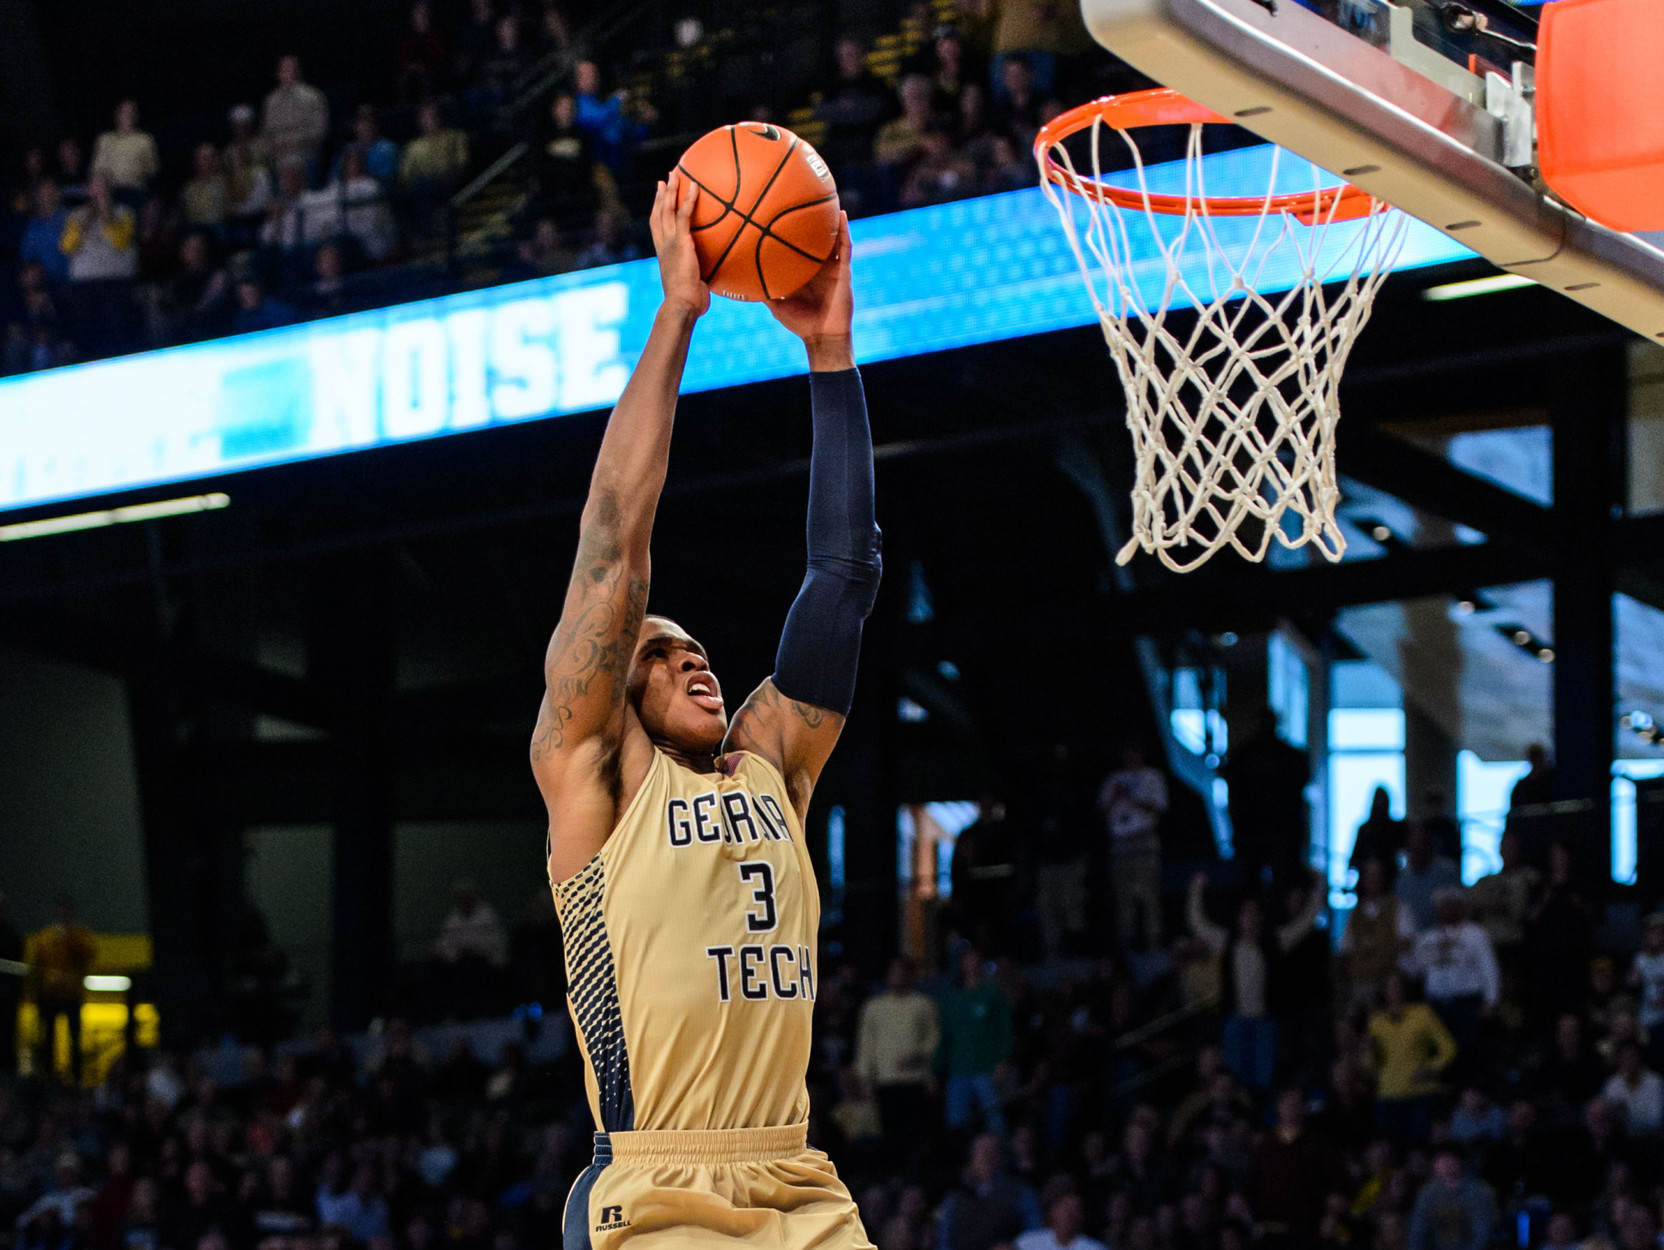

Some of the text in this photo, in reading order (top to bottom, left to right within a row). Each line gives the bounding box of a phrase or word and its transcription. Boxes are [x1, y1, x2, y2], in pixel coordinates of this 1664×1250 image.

[303, 281, 630, 453] NOISE
[668, 790, 794, 848] GERIA
[738, 860, 779, 934] 3
[706, 943, 816, 1003] TECH
[595, 1220, 632, 1232] RUSSELL
